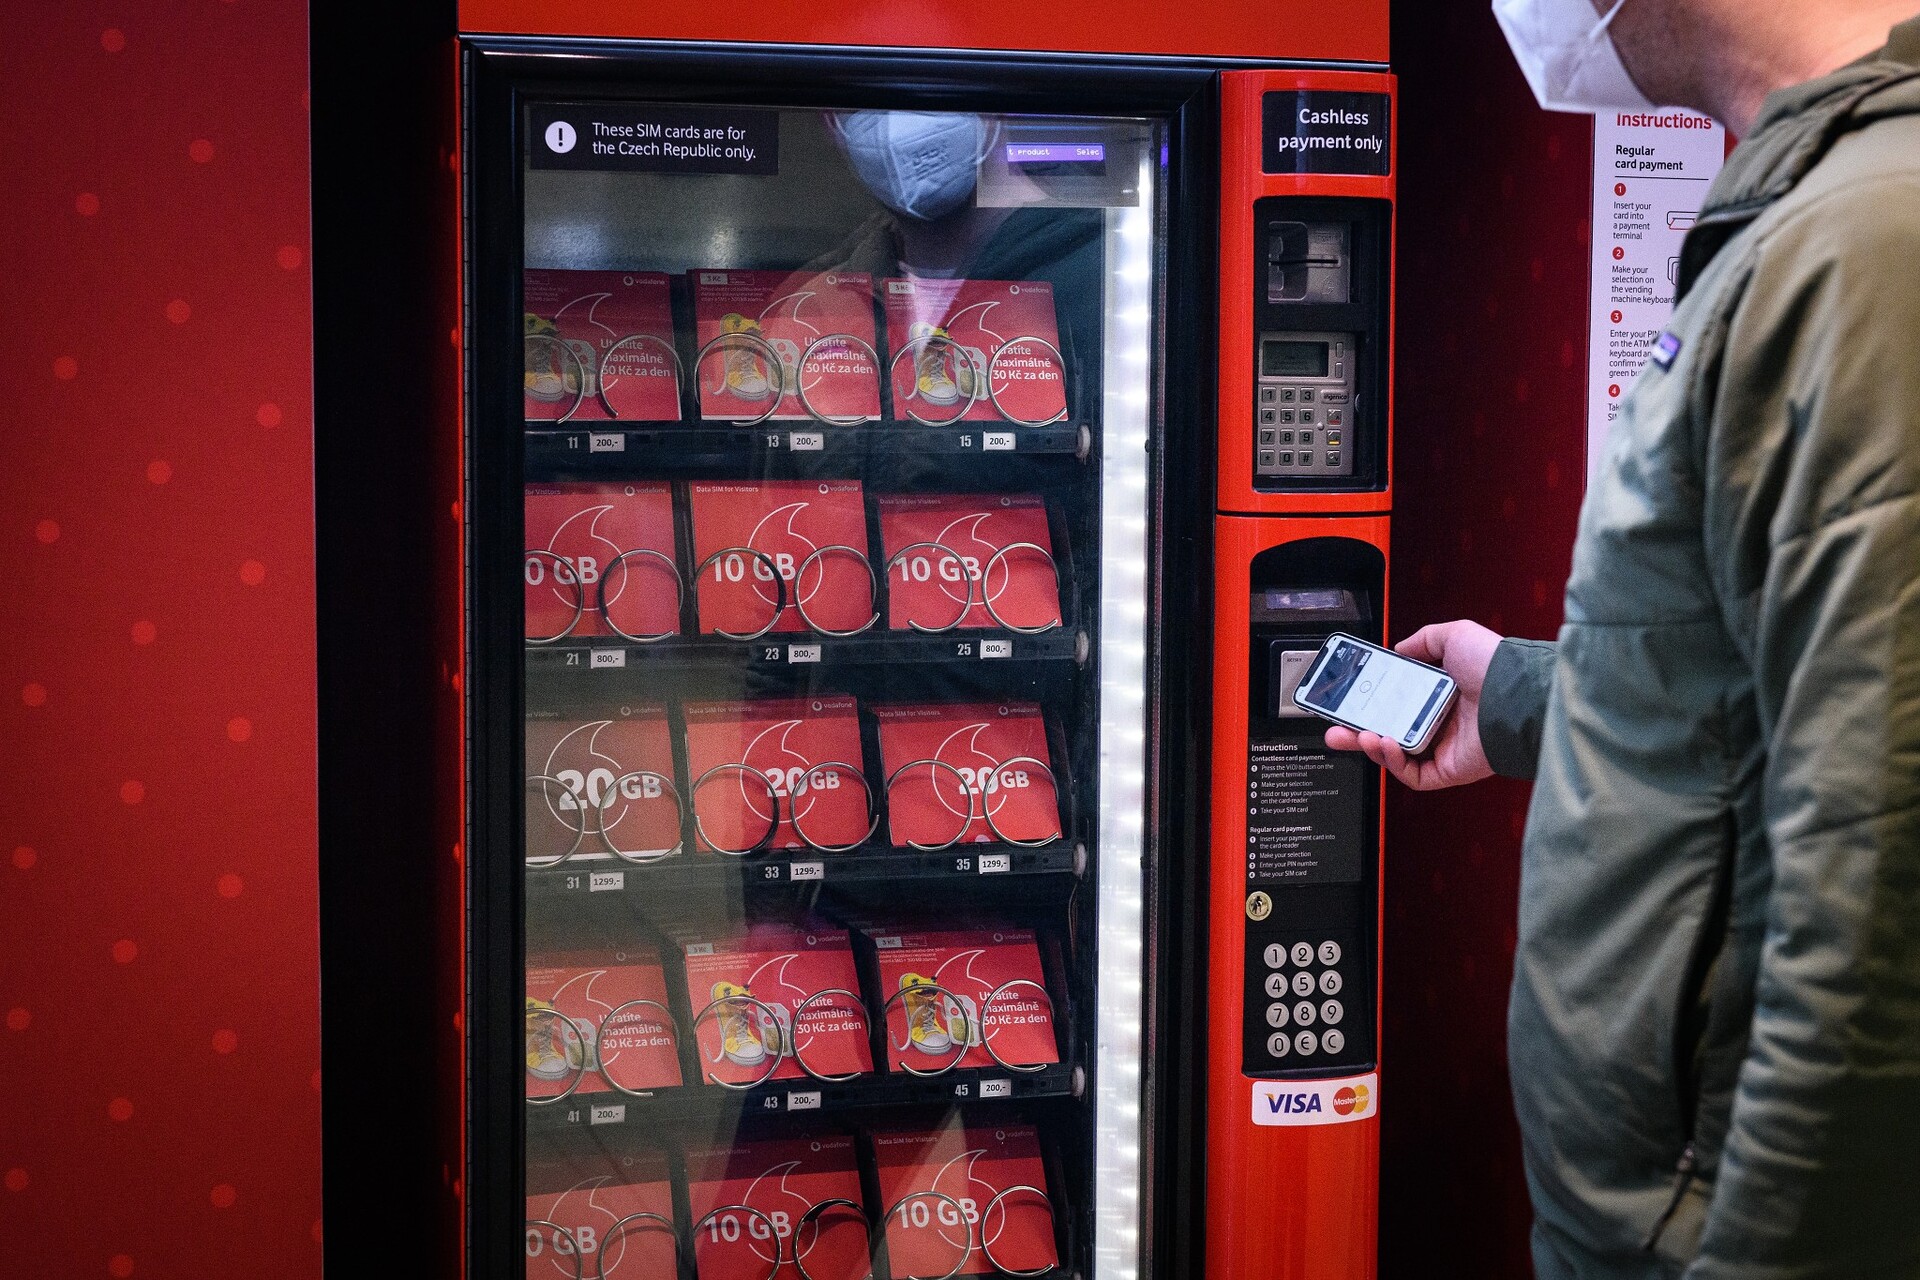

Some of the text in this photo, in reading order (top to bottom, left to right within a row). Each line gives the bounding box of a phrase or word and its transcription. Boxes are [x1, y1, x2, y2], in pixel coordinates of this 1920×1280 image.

[1300, 109, 1369, 124] Cashless
[1616, 113, 1712, 129] Instructions
[592, 122, 746, 140] These SIM cards are for
[1279, 135, 1382, 153] payment only
[592, 141, 756, 161] the Czech Republic only.
[1616, 145, 1655, 156] Regular
[1615, 159, 1683, 171] card payment
[1635, 203, 1651, 211] your
[1614, 212, 1644, 220] card into
[1619, 222, 1650, 230] payment
[1613, 232, 1642, 240] terminal
[1612, 265, 1648, 275] Make your
[1611, 285, 1652, 295] the vending
[1611, 295, 1675, 305] machine keyboard
[1630, 331, 1646, 339] your
[1609, 350, 1642, 358] keyboard
[806, 363, 873, 374] 30 Kč za den
[1609, 359, 1637, 367] confirm
[993, 369, 1058, 380] 30 Kč za den
[1609, 370, 1630, 378] green
[567, 437, 578, 448] 11
[596, 439, 618, 447] 200,-
[767, 435, 779, 447] 13
[796, 437, 817, 446] 200,-
[960, 435, 972, 447] 15
[989, 437, 1010, 446] 200,-
[553, 556, 599, 585] GB
[710, 553, 796, 582] 10 GB
[895, 556, 982, 582] 10 GB
[765, 648, 779, 660] 23
[794, 649, 814, 658] 800,-
[958, 644, 971, 655] 25
[985, 644, 1006, 653] 800,-
[566, 653, 579, 665] 21
[597, 655, 619, 663] 800,-
[764, 766, 840, 798] 20 GB
[958, 766, 1029, 795] 20 GB
[556, 767, 662, 811] 20 GB
[956, 859, 970, 870] 35
[982, 859, 1007, 868] 1299,-
[765, 867, 779, 878] 33
[794, 867, 820, 876] 1299,-
[566, 877, 580, 889] 31
[593, 878, 620, 886] 1299,-
[1272, 946, 1335, 963] 1 2 3
[1272, 975, 1336, 993] 4 5 6
[998, 1014, 1047, 1025] Kč za den
[1273, 1005, 1337, 1023] 7 8 9
[797, 1020, 862, 1034] 30 Kč za den
[603, 1036, 670, 1049] 30 Kč za den
[1274, 1037, 1284, 1052] 0
[1328, 1034, 1336, 1048] C
[955, 1085, 969, 1096] 45
[986, 1084, 1006, 1092] 200,-
[764, 1097, 778, 1109] 43
[794, 1096, 815, 1105] 200,-
[1264, 1093, 1322, 1114] VISA
[567, 1110, 580, 1123] 41
[597, 1110, 619, 1119] 200,-
[896, 1198, 980, 1229] 10 GB
[704, 1211, 792, 1243] 10 GB
[552, 1226, 597, 1256] GB
